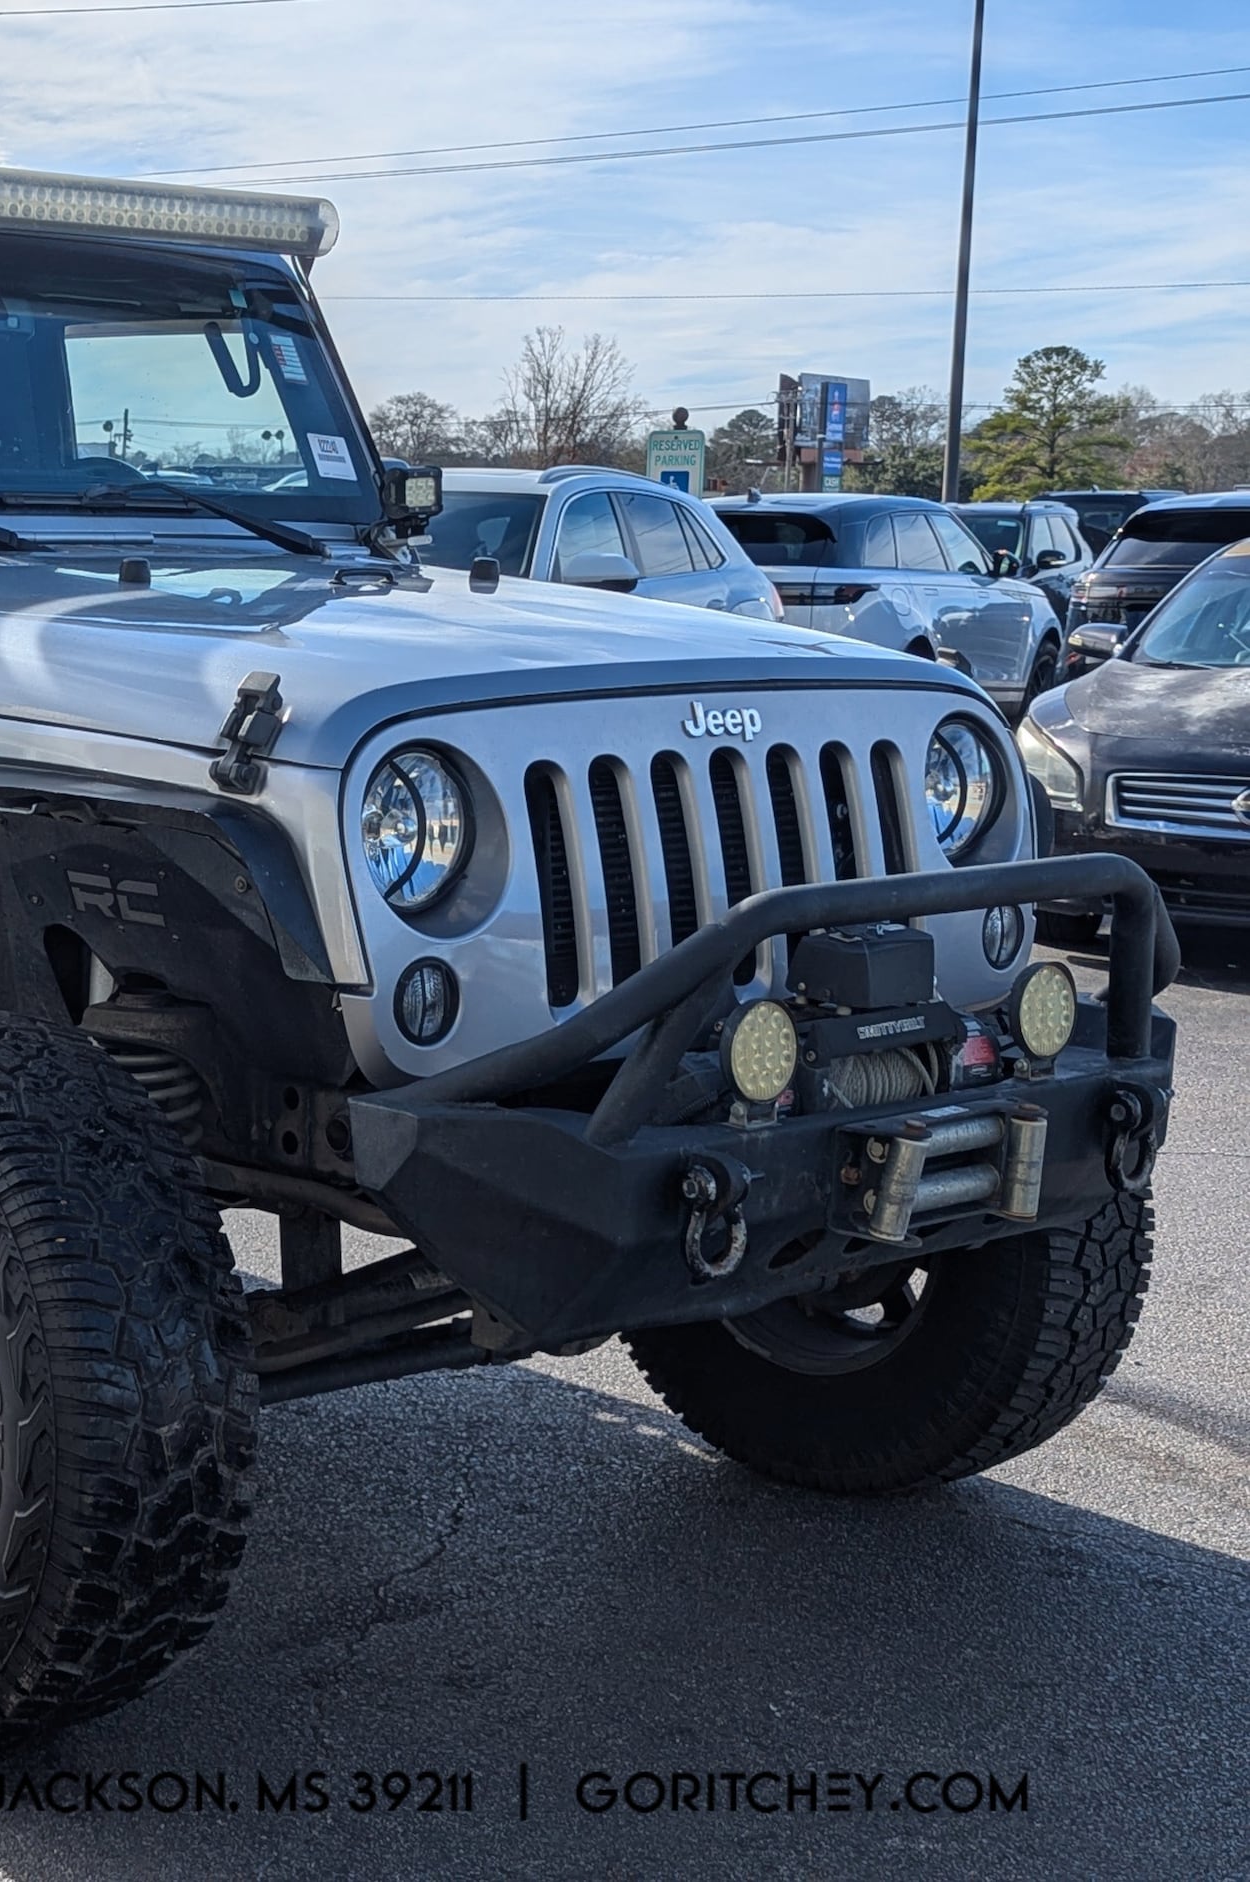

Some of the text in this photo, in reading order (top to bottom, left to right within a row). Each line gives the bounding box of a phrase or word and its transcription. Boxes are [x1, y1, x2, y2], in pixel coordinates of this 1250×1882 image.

[652, 439, 700, 451] RESERVED
[654, 455, 696, 466] PARKING
[681, 700, 762, 742] Jeep
[66, 869, 166, 928] RC
